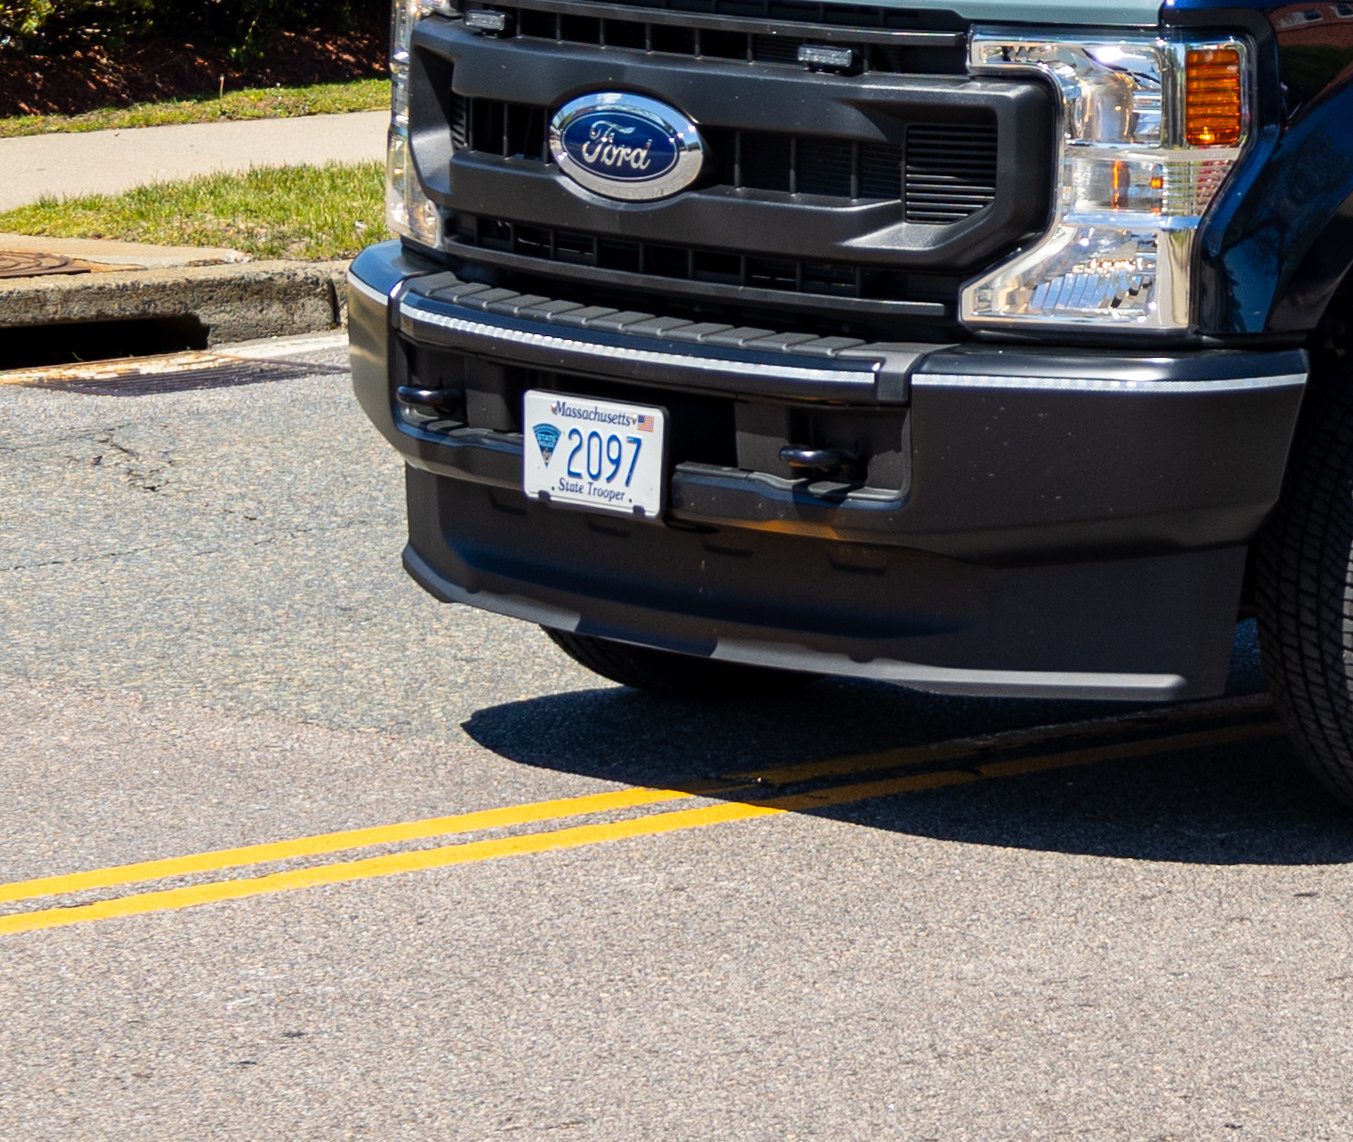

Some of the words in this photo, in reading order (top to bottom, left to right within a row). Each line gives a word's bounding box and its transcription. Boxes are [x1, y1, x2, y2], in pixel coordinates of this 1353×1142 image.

[582, 120, 653, 170] Ford
[556, 400, 631, 427] Massachusetts
[567, 427, 643, 488] 2097
[558, 477, 584, 495] State
[587, 481, 626, 502] Trooper
